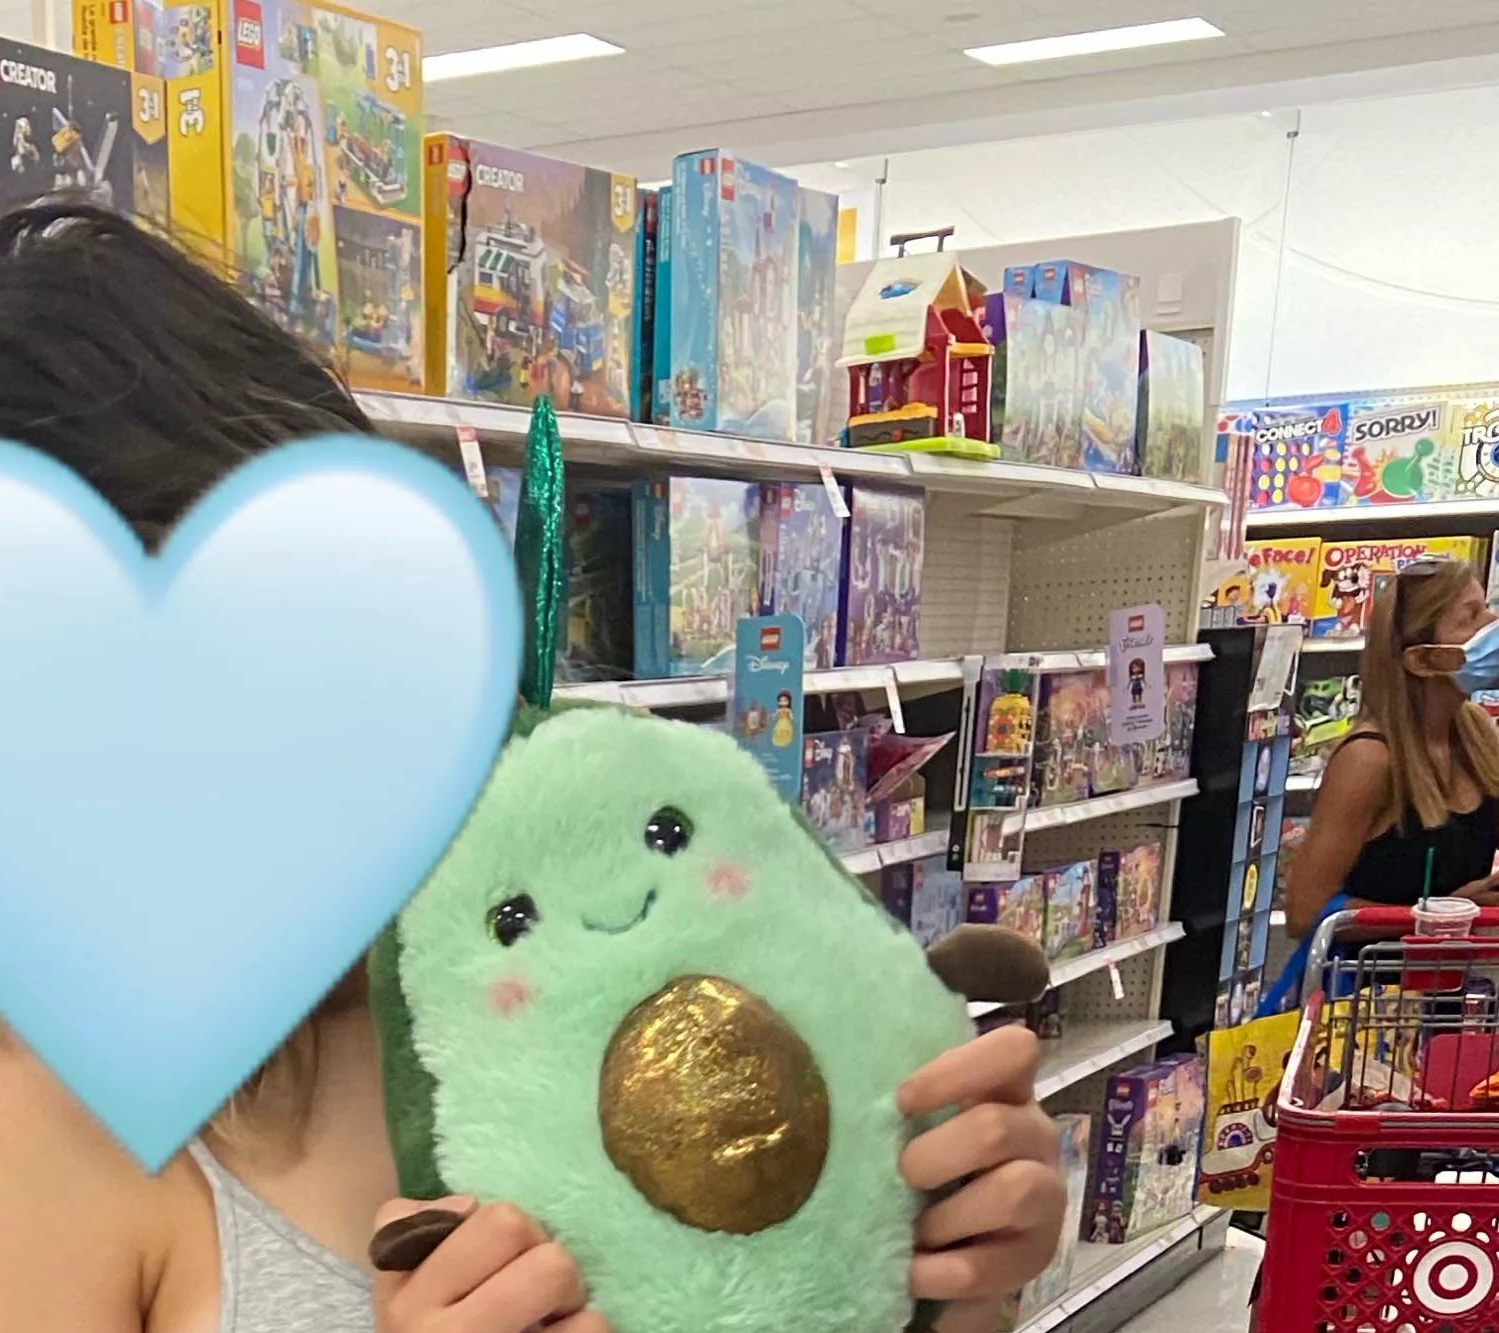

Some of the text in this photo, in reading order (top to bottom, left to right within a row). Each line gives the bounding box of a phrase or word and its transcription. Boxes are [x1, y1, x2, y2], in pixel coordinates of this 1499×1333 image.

[237, 18, 261, 46] LEGO
[0, 58, 57, 94] CREATOR
[476, 163, 525, 193] CREATOR
[1256, 407, 1343, 444] CONNECT 4
[1355, 410, 1438, 442] SORRY!
[1263, 546, 1317, 565] Face!
[1325, 544, 1427, 568] OPERATION
[745, 655, 790, 675] Disney
